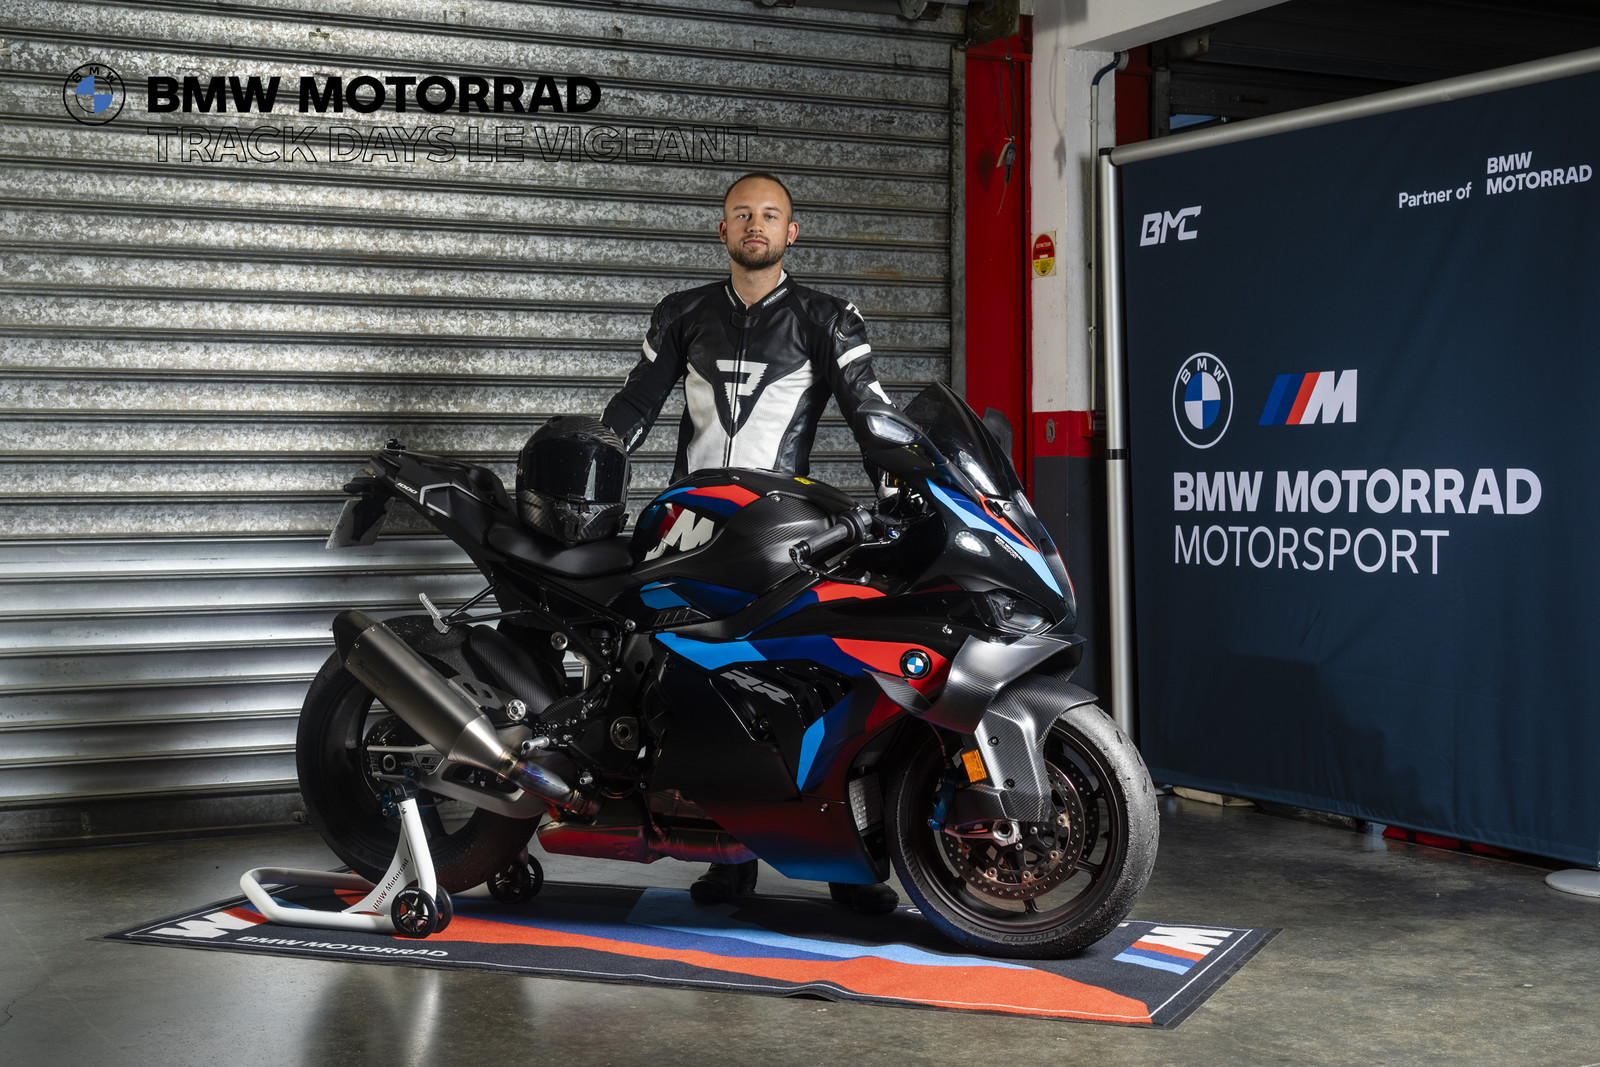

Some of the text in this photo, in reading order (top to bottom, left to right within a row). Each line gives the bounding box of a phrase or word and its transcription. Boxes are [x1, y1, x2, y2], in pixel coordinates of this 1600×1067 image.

[1486, 151, 1533, 174] BMW
[1486, 164, 1592, 195] MOTORRAD
[1398, 182, 1472, 209] Partner of
[1139, 205, 1202, 247] BMC
[1180, 357, 1225, 386] BMW
[396, 482, 418, 495] 1000
[1173, 468, 1542, 515] BMW MOTORRAD
[1174, 525, 1450, 575] MOTORSPORT
[373, 858, 409, 910] BMW Motorrad
[235, 935, 450, 957] BMW MOTORRAD
[1005, 931, 1056, 942] MICHELIN
